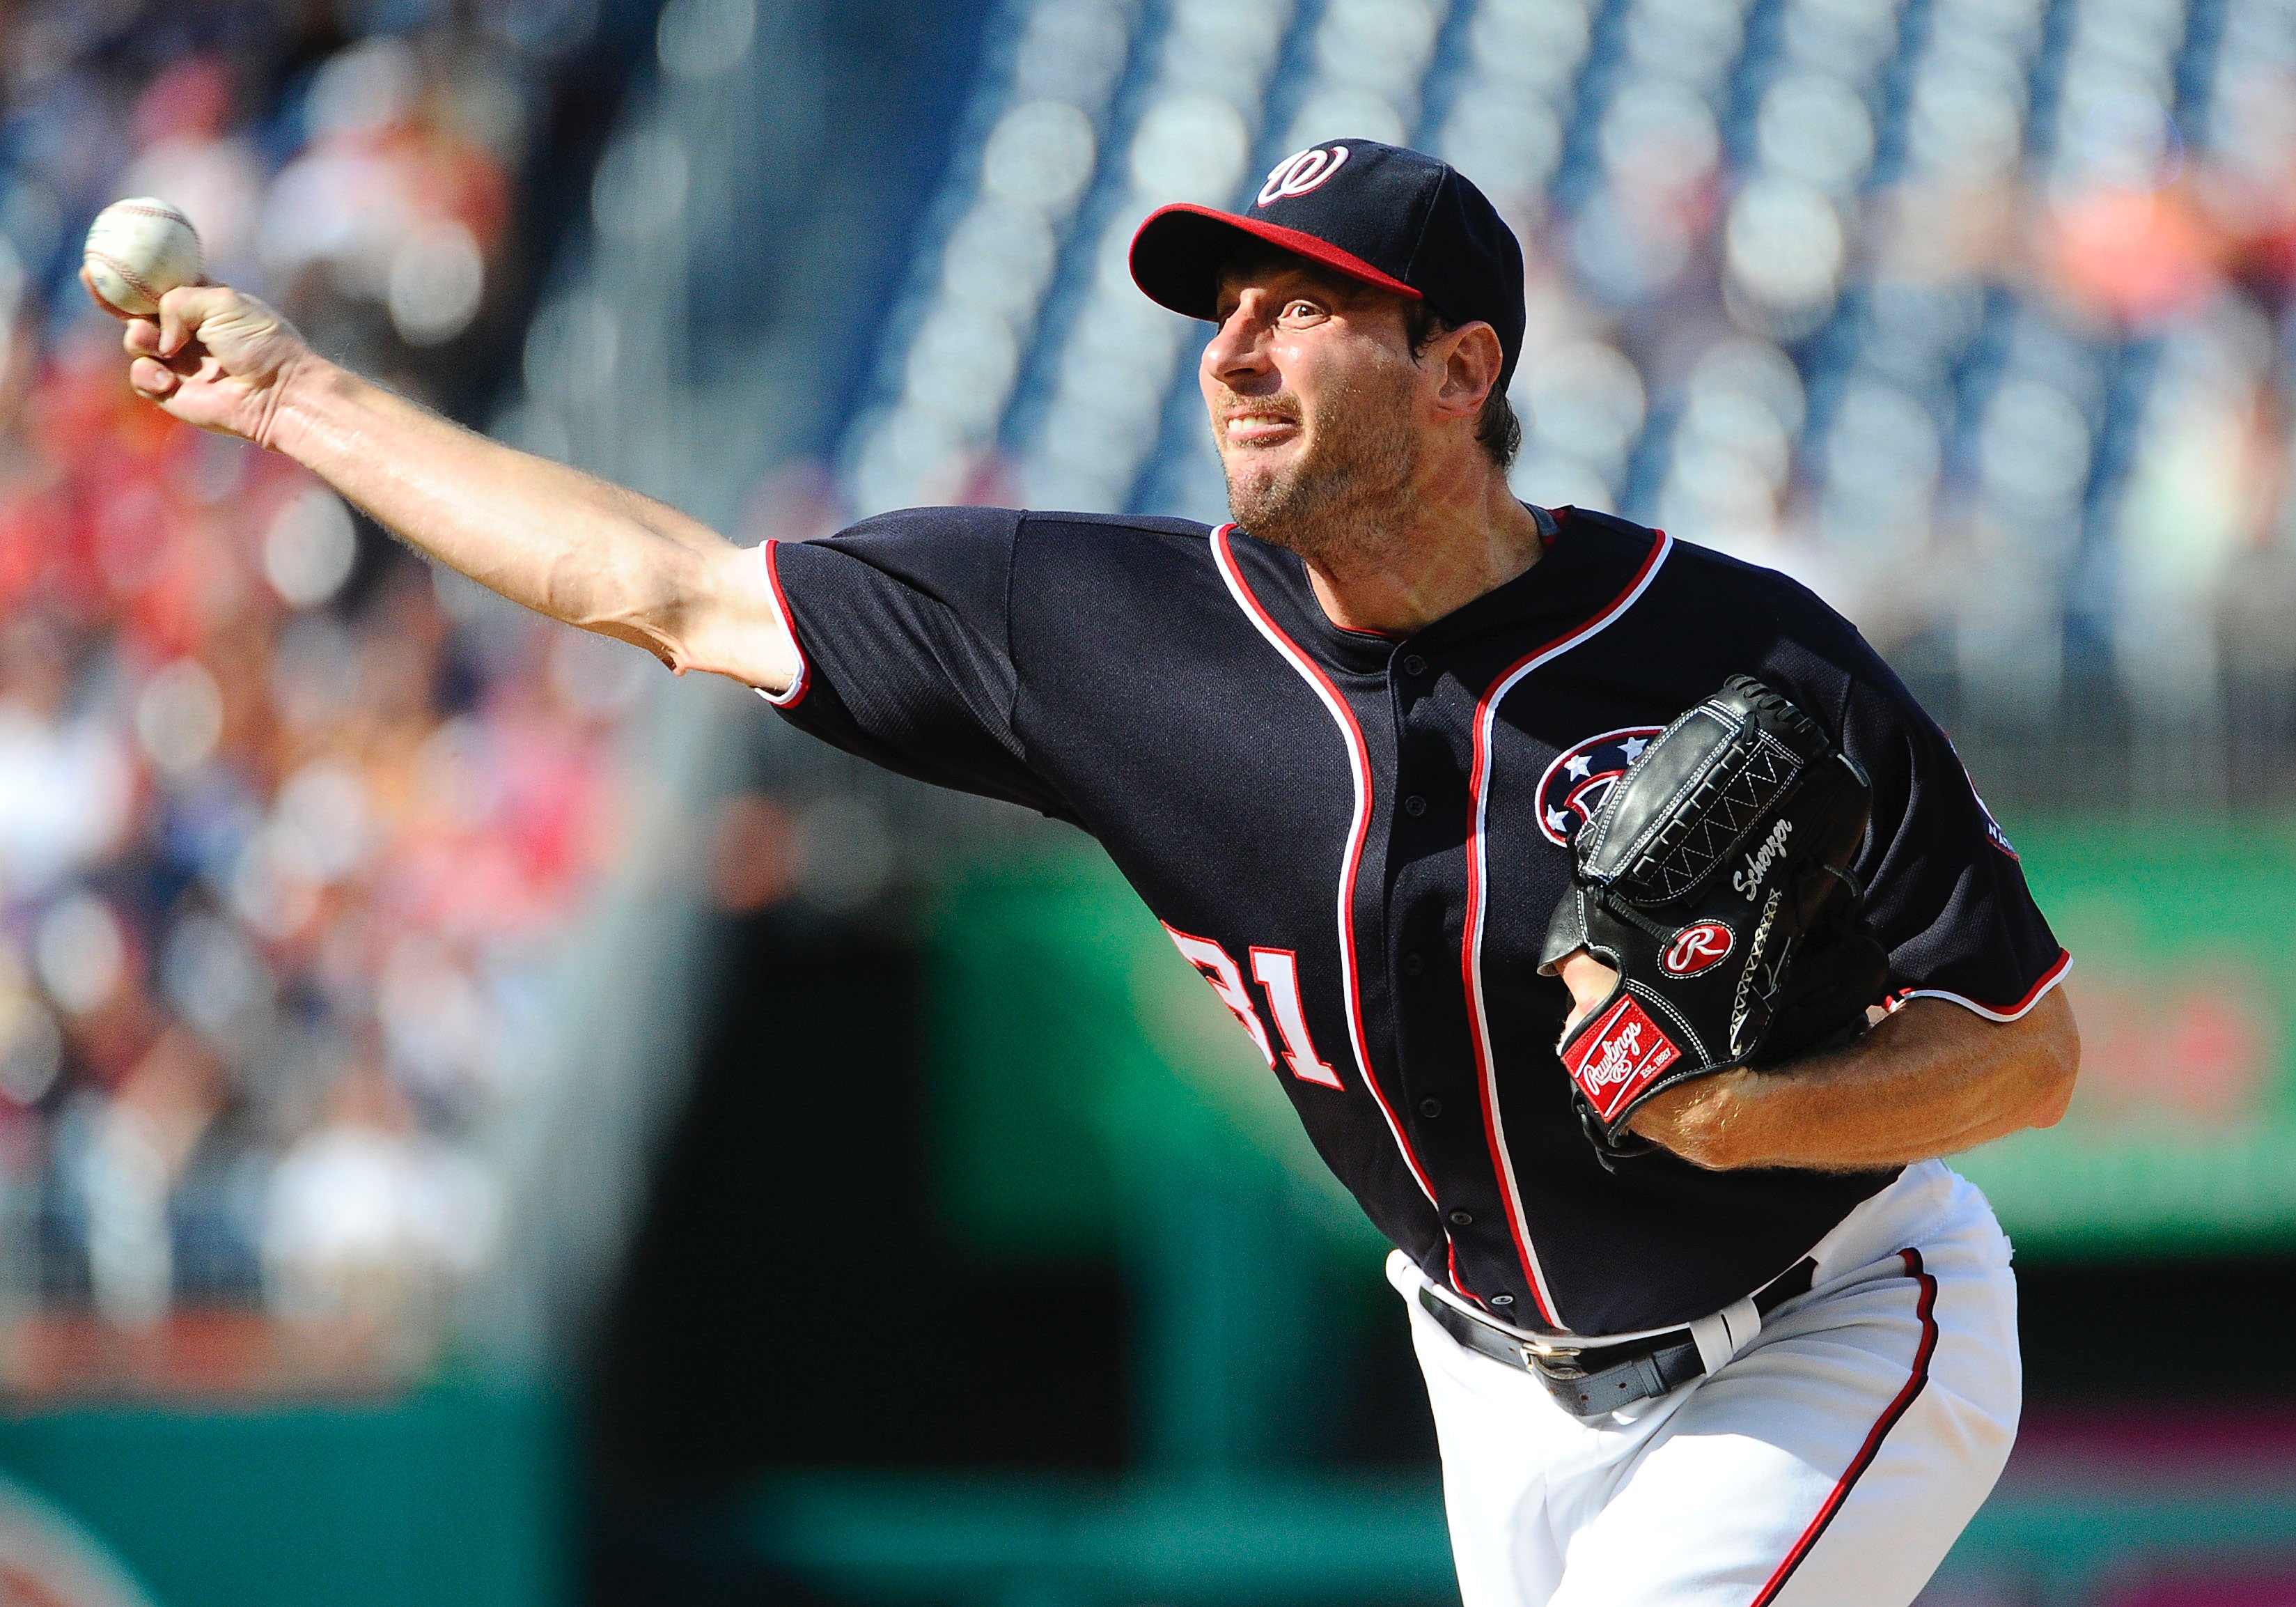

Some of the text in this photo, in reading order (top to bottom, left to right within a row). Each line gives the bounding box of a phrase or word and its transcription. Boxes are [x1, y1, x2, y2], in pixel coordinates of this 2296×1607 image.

[1257, 146, 1349, 208] W
[1733, 818, 1793, 901] Scherzer
[1668, 928, 1725, 970] R
[1584, 1021, 1641, 1096] Rawlings
[1639, 1047, 1671, 1079] Est. 1887
